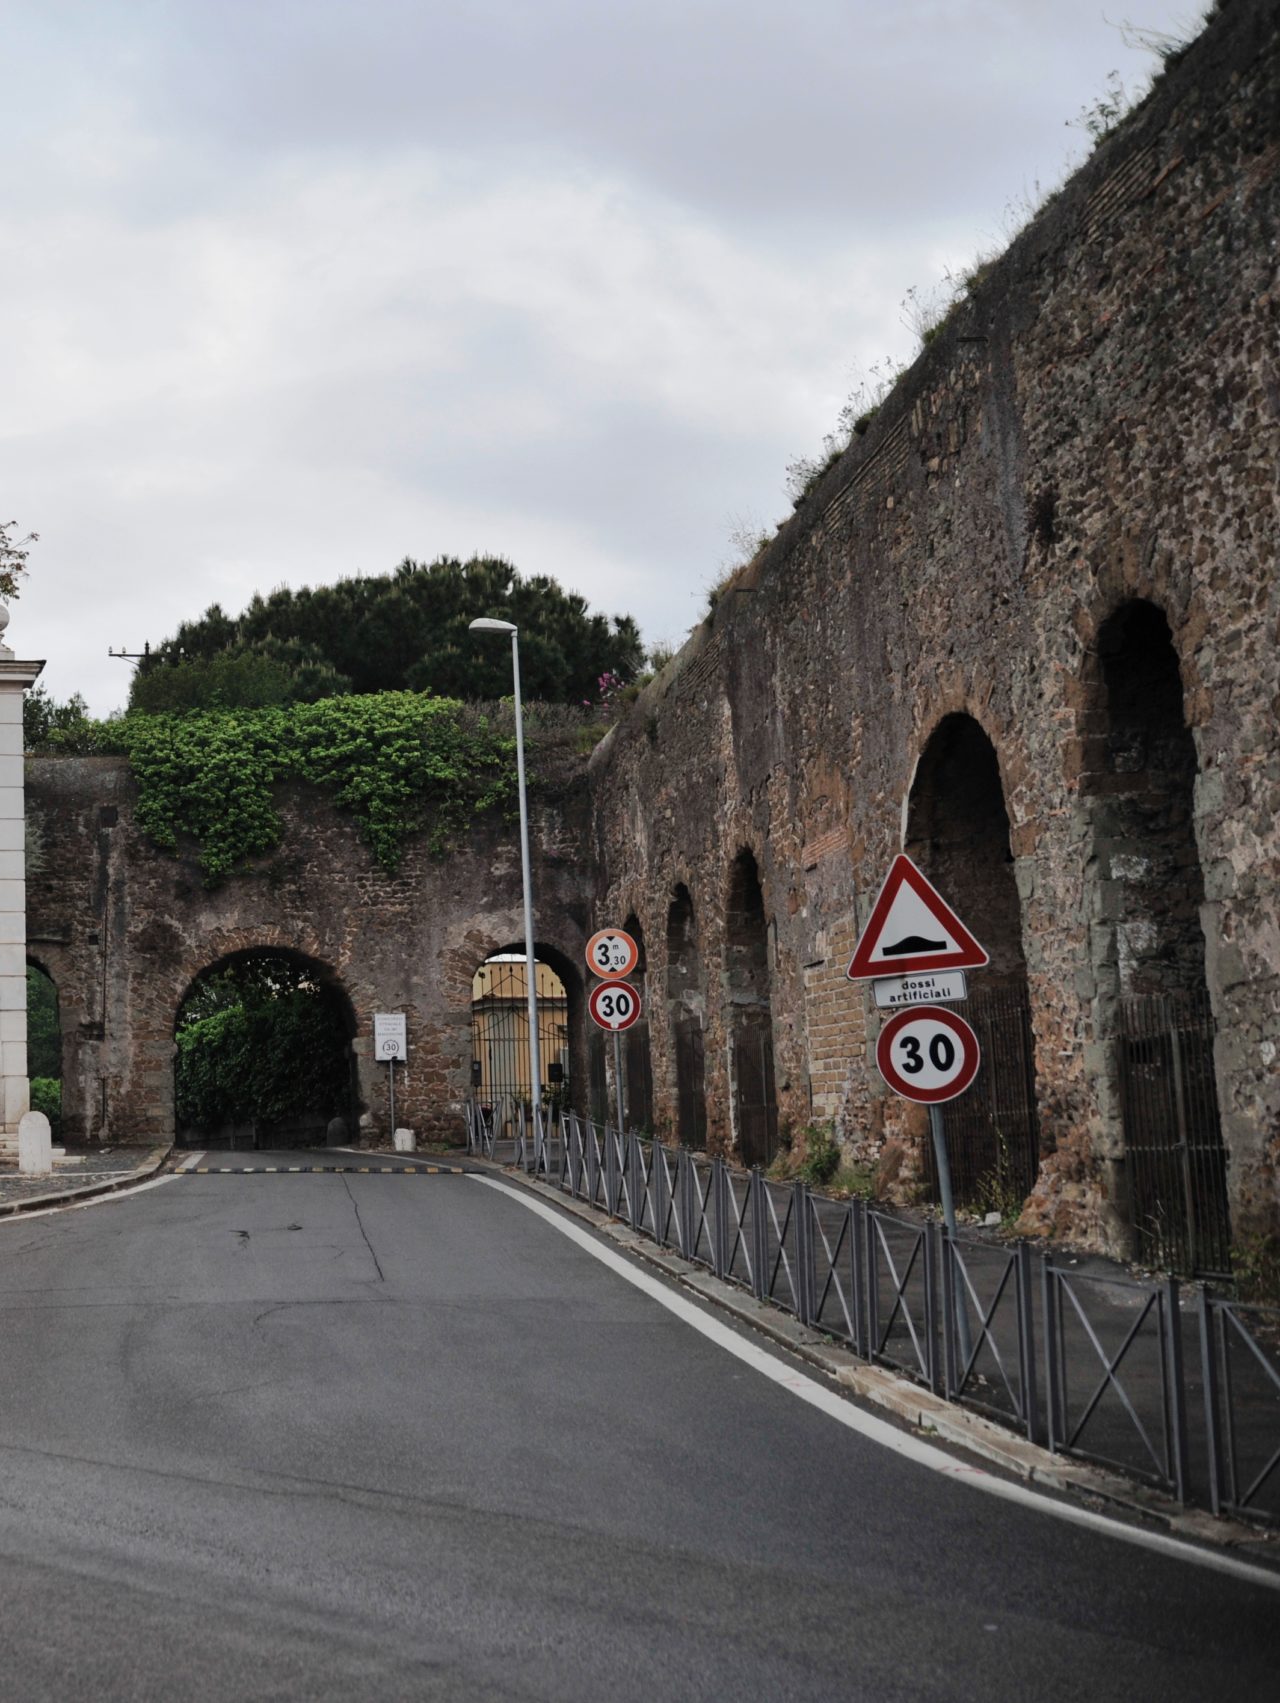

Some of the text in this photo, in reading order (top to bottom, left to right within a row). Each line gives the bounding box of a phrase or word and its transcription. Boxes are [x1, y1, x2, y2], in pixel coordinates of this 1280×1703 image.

[901, 977, 935, 990] dossi
[889, 987, 951, 1003] artificiali
[601, 993, 630, 1018] 30
[386, 1043, 396, 1051] 30
[899, 1033, 956, 1075] 30
